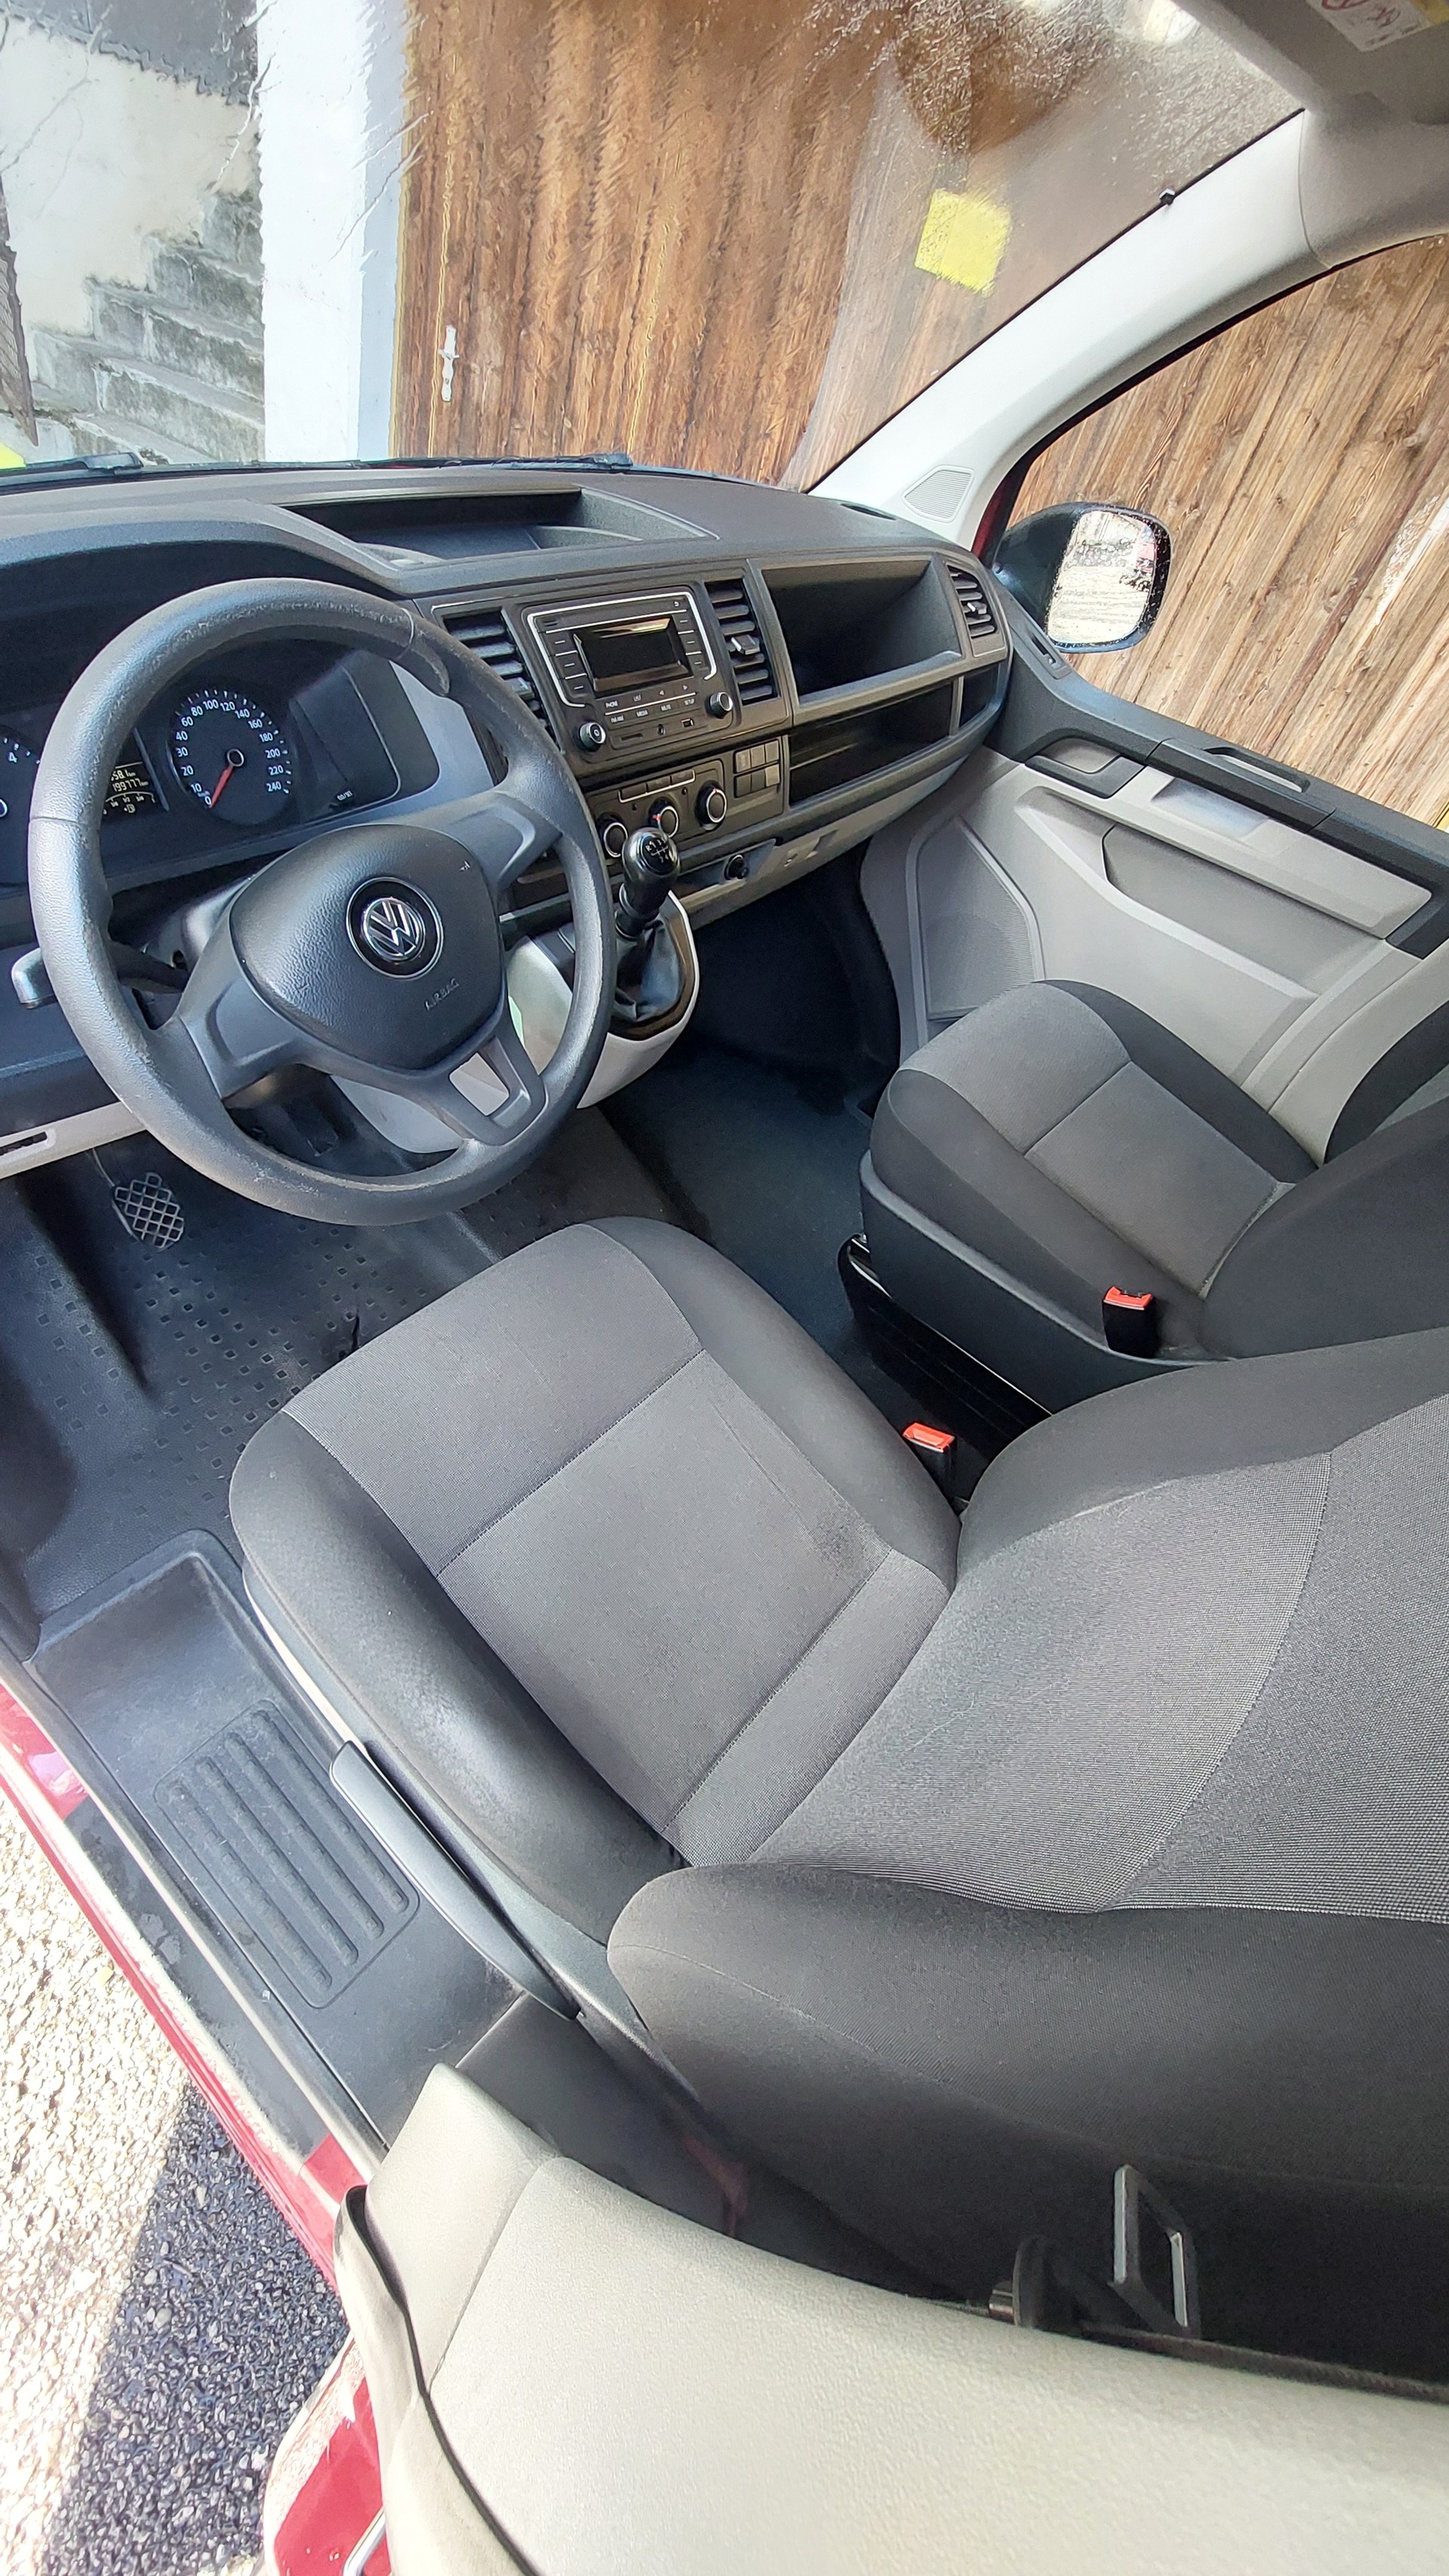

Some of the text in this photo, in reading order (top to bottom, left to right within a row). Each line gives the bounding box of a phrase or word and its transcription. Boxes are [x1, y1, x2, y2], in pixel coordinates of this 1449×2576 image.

[203, 699, 219, 710] 100
[220, 701, 235, 712] 120
[190, 706, 204, 717] 80
[235, 708, 250, 719] 140
[180, 716, 194, 727] 60
[248, 719, 263, 730] 160
[175, 731, 189, 741] 40
[259, 732, 274, 743] 180
[8, 752, 17, 763] 4
[175, 746, 189, 758] 30
[265, 748, 281, 759] 200
[180, 765, 194, 776] 20
[268, 765, 284, 776] 220
[190, 783, 202, 793] 10
[266, 780, 281, 792] 240
[205, 796, 212, 805] 0
